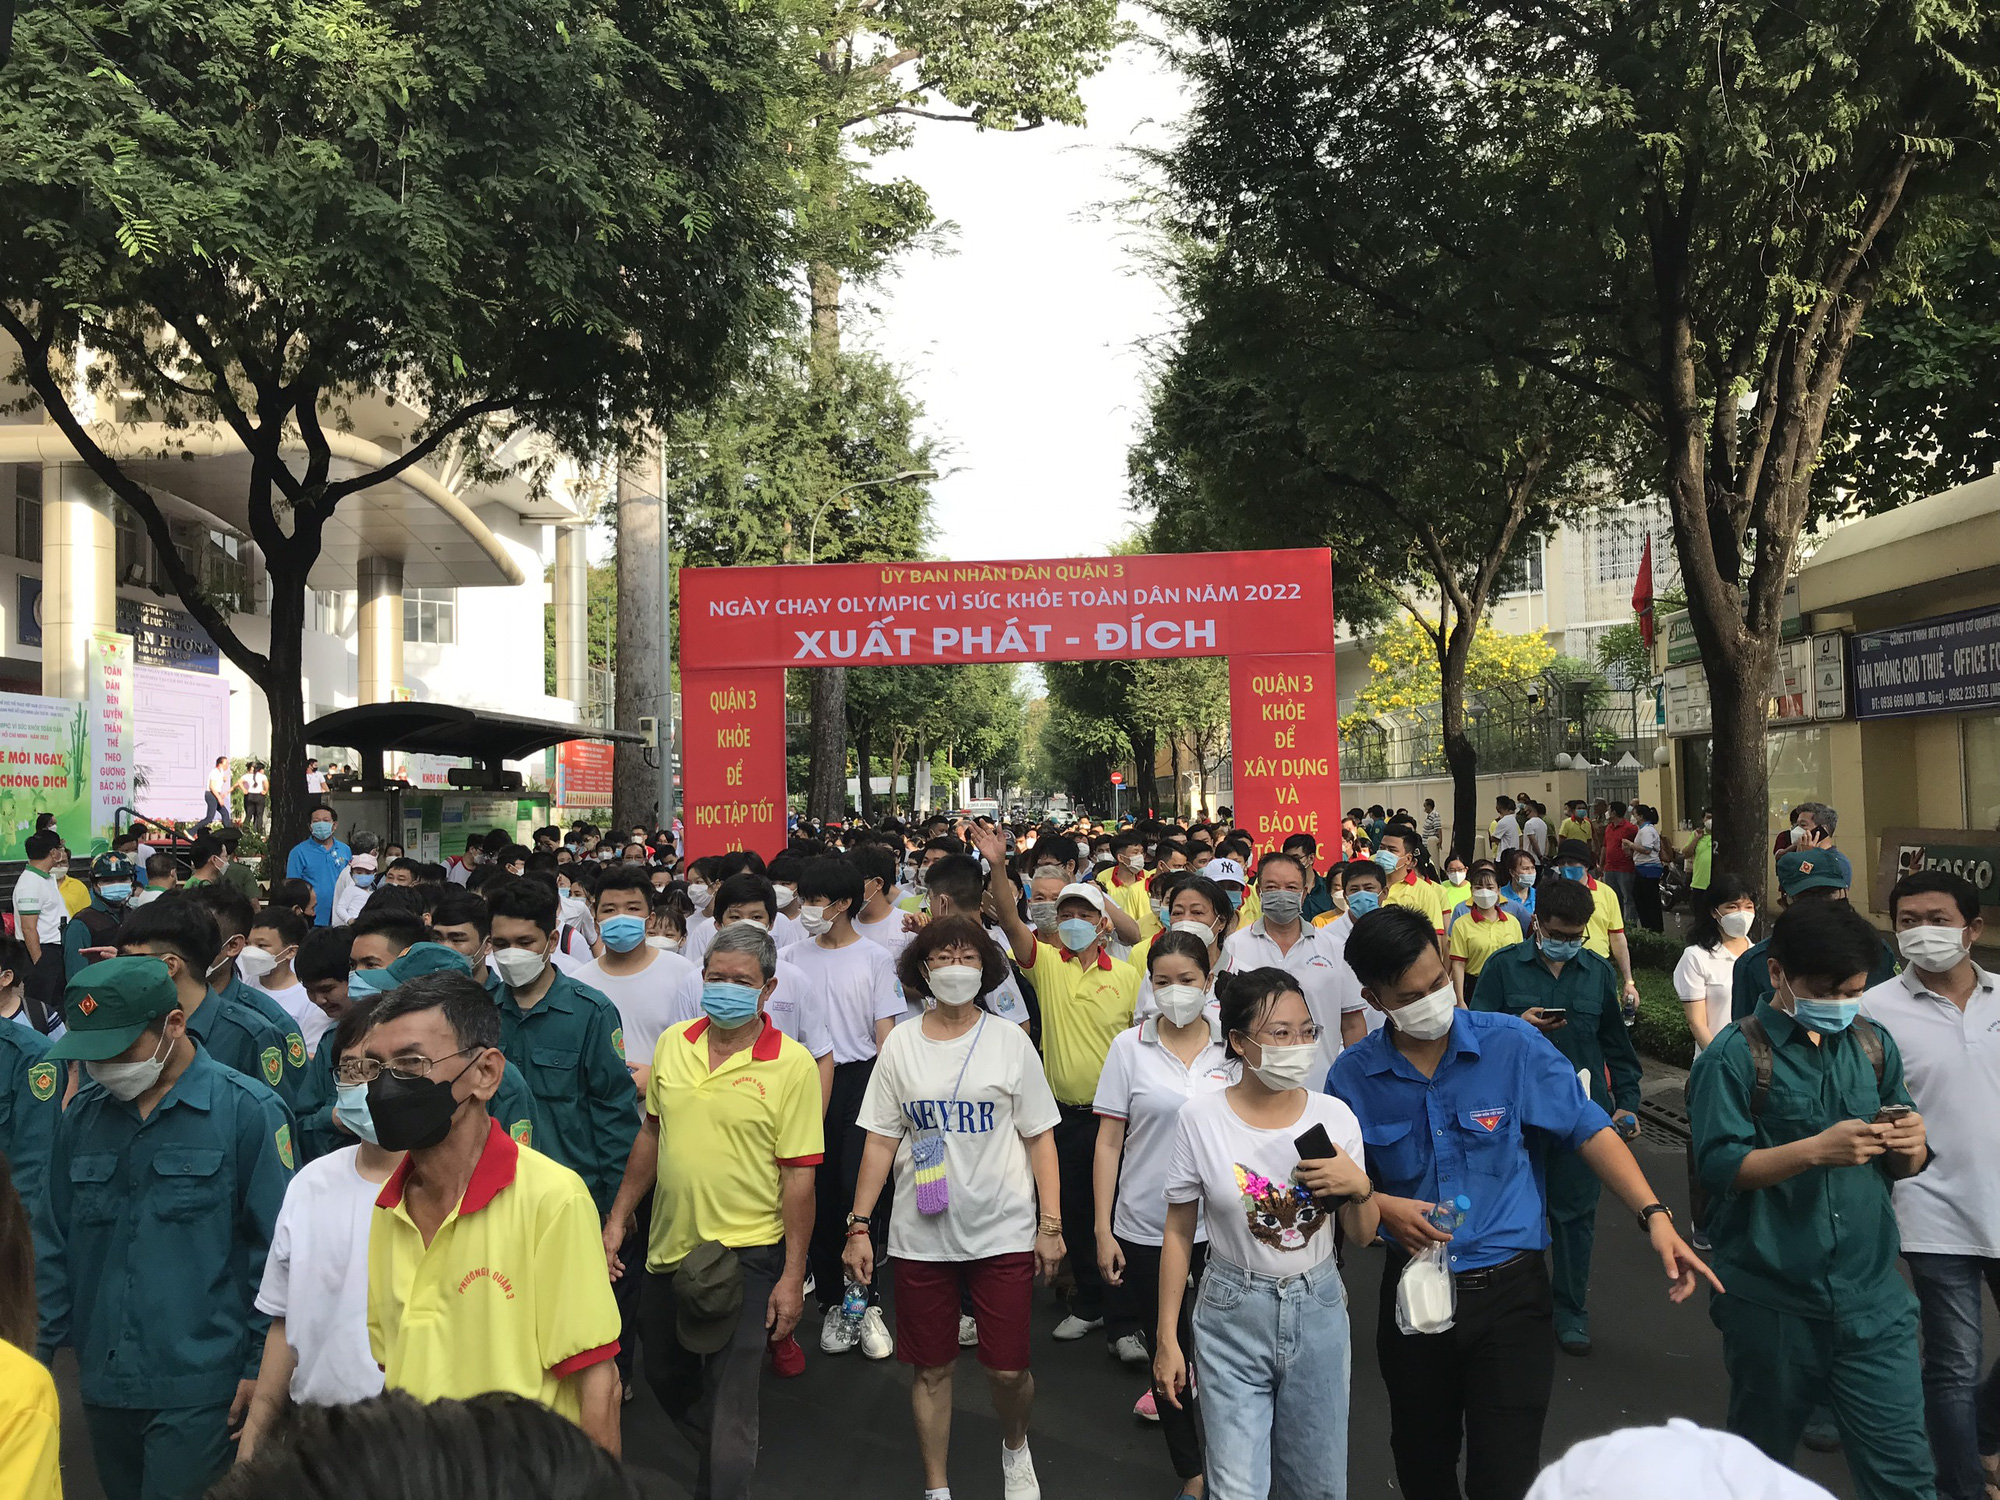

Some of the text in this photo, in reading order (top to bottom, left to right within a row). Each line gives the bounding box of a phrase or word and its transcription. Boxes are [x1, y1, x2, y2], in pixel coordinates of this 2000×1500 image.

[881, 561, 1124, 584] ỦY BAN NHÂN DÂN QUẬN 3
[709, 582, 1302, 617] NGÀY CHẠY OLYMPIC VÌ SỨC KHỎE TOÀN DÂN NĂM 2022
[793, 614, 917, 660] XUẤT
[932, 616, 1052, 656] PHÁT
[1093, 612, 1217, 651] ĐÍCH
[1904, 631, 1912, 643] TY
[1912, 628, 1928, 643] TNHH
[1928, 625, 1941, 640] MTV
[1941, 621, 1956, 639] DỊCH
[1955, 621, 1964, 636] VỤ
[1975, 616, 1992, 633] QUAN
[103, 663, 122, 677] TOÀN
[1857, 658, 1874, 690] VĂN
[1874, 653, 1901, 688] PHÒNG
[1902, 655, 1920, 684] CHO
[1921, 644, 1946, 681] THUÊ
[1953, 644, 1987, 677] OFFICE
[105, 679, 120, 691] DÂN
[1252, 672, 1314, 697] QUẬN 3
[1893, 693, 1904, 707] 669
[1903, 692, 1915, 706] 000
[1948, 687, 1964, 702] 0982
[1964, 685, 1976, 700] 233
[1976, 683, 1989, 698] 978
[106, 693, 119, 706] RÈN
[709, 686, 757, 715] QUẬN 3
[1261, 698, 1306, 721] KHỎE
[103, 707, 123, 723] LUYỆN
[103, 721, 122, 734] THÂN
[717, 722, 751, 749] KHỎE
[1274, 724, 1296, 749] ĐỂ
[106, 734, 119, 748] THỂ
[34, 750, 65, 768] NGÀY,
[104, 752, 122, 763] THEO
[1243, 756, 1329, 780] XÂY DỰNG
[0, 771, 68, 791] CHỐNG DỊCH
[99, 765, 126, 778] GƯƠNG
[726, 757, 744, 787] ĐỂ
[99, 777, 127, 792] BÁC HỒ
[1275, 783, 1300, 805] VÀ
[110, 795, 124, 807] ĐẠI
[695, 797, 774, 829] HỌC TẬP TỐT
[1258, 810, 1319, 836] BẢO VỆ
[726, 838, 744, 854] VÀ
